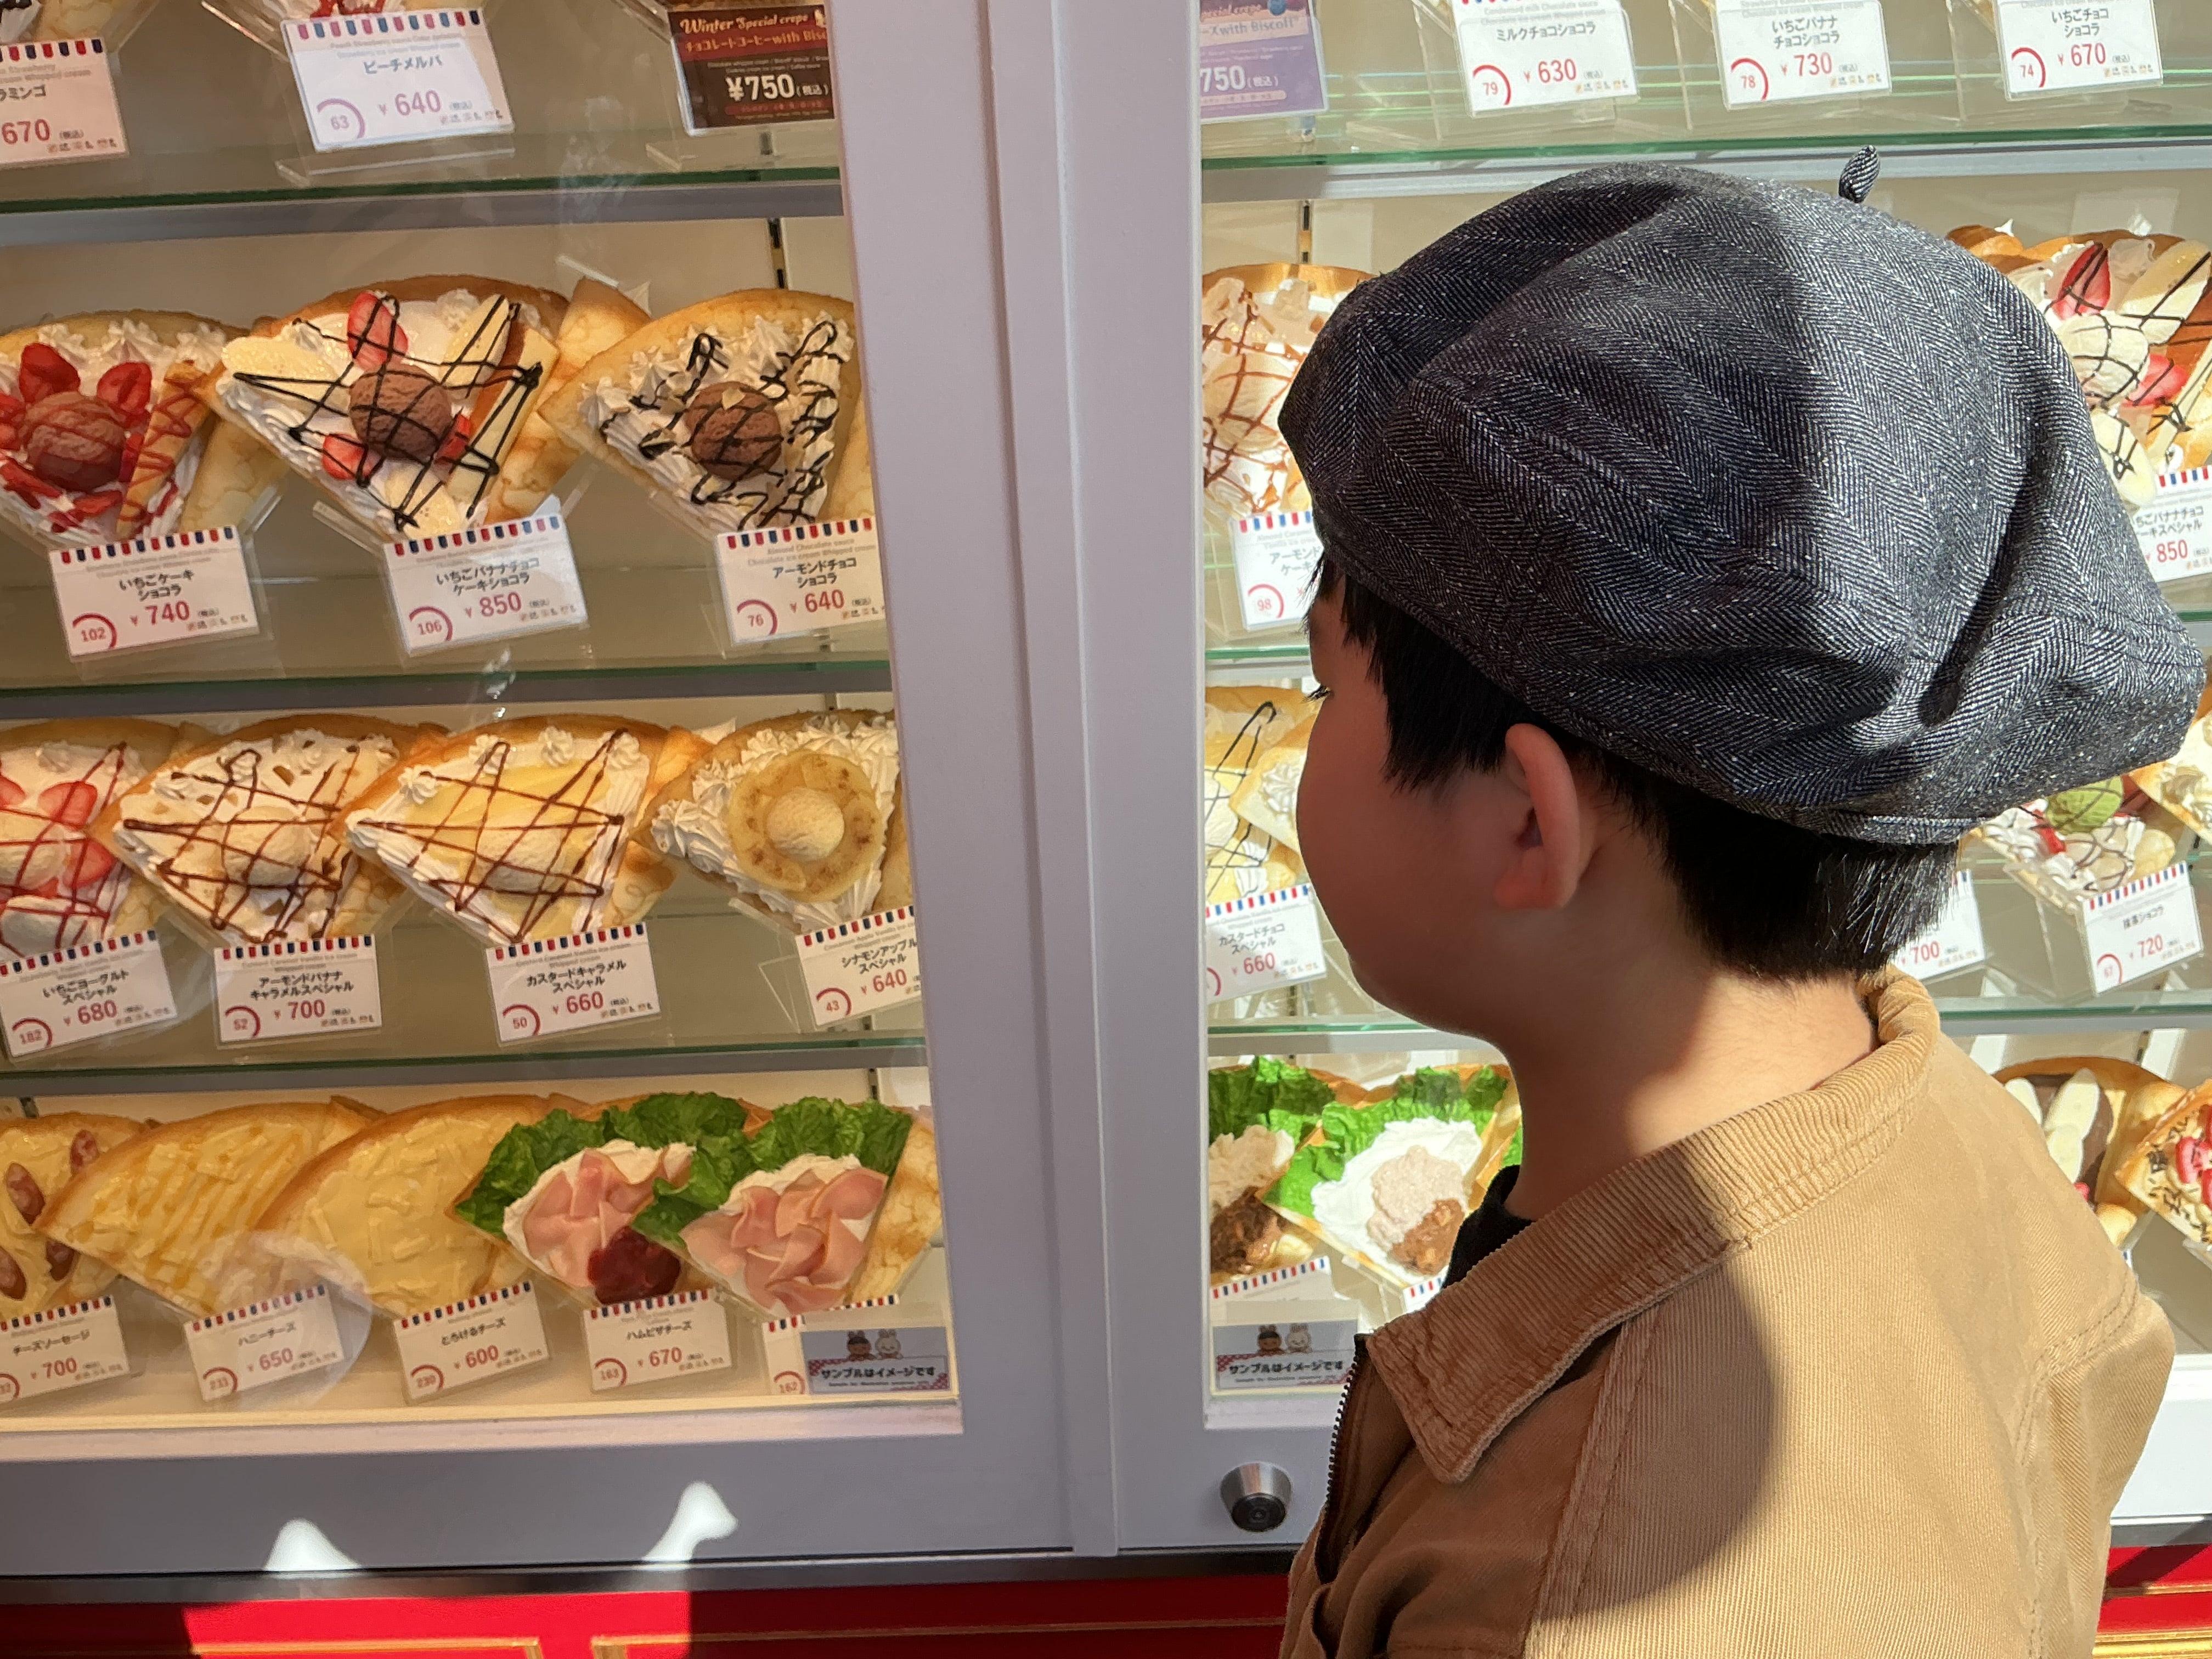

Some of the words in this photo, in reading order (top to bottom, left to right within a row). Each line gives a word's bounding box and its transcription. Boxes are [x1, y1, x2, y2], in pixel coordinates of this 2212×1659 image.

[680, 19, 734, 34] Winter
[736, 14, 777, 30] Special
[1771, 15, 1838, 33] いちごバナナ
[2051, 8, 2109, 24] いちごチョコ
[1497, 21, 1596, 42] ミルクチョコショコラ
[1774, 31, 1840, 49] チョコショコラ
[2064, 22, 2100, 38] ショコラ
[1794, 52, 1832, 77] 730
[2071, 43, 2106, 66] 670
[1199, 65, 1246, 93] 750
[1538, 58, 1577, 83] 630
[2020, 64, 2034, 78] 74
[726, 74, 795, 101] ¥750
[1483, 82, 1498, 95] 79
[1741, 75, 1756, 89] 78
[395, 89, 442, 116] 640
[2, 119, 50, 144] 670
[2157, 539, 2188, 563] 850
[436, 557, 540, 585] いちごバナナチョコ
[772, 557, 857, 578] アーモンドチョコ
[119, 569, 194, 591] いちごケーキ
[453, 572, 530, 596] ケーキショコラ
[797, 572, 837, 588] ショコラ
[138, 584, 182, 602] ショコラ
[479, 591, 522, 617] 850
[805, 589, 845, 613] 640
[145, 601, 190, 625] 740
[748, 614, 764, 627] 76
[81, 627, 106, 642] 102
[1219, 923, 1285, 947] カスタードチョコ
[1232, 936, 1276, 955] スペシャル
[2138, 933, 2163, 957] 720
[1244, 952, 1275, 974] 660
[1910, 940, 1939, 964] 700
[526, 960, 627, 987] カスタードキャラメル
[859, 953, 906, 974] スペシャル
[552, 976, 605, 994] スペシャル
[873, 969, 907, 992] 640
[77, 999, 117, 1025] 680
[287, 999, 325, 1020] 700
[566, 991, 604, 1014] 660
[827, 1001, 839, 1012] 43
[259, 1347, 293, 1370] 650
[466, 1345, 498, 1368] 600
[649, 1347, 682, 1367] 670
[1229, 1360, 1344, 1374] サンプルはイメージです
[42, 1357, 77, 1379] 700
[822, 1365, 935, 1379] サンプルはイメージです
